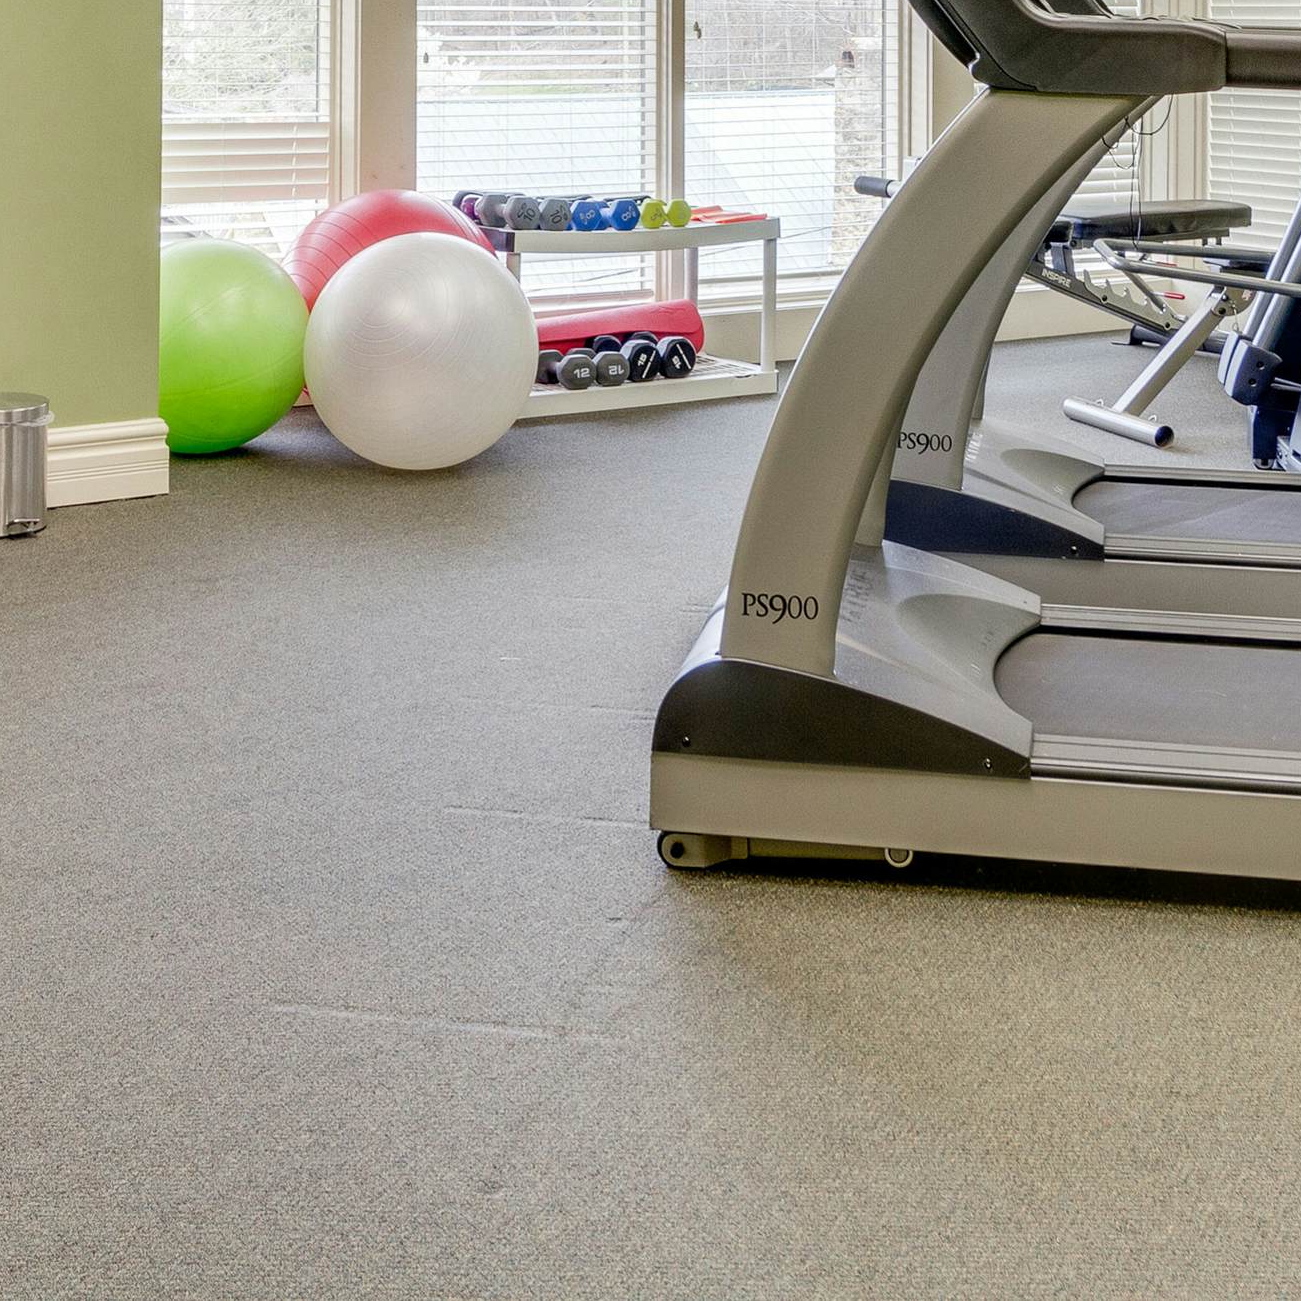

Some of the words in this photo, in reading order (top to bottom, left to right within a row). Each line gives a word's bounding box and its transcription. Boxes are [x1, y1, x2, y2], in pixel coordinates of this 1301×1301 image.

[573, 367, 591, 379] 12
[897, 430, 953, 455] PS900
[741, 592, 819, 625] PS900
